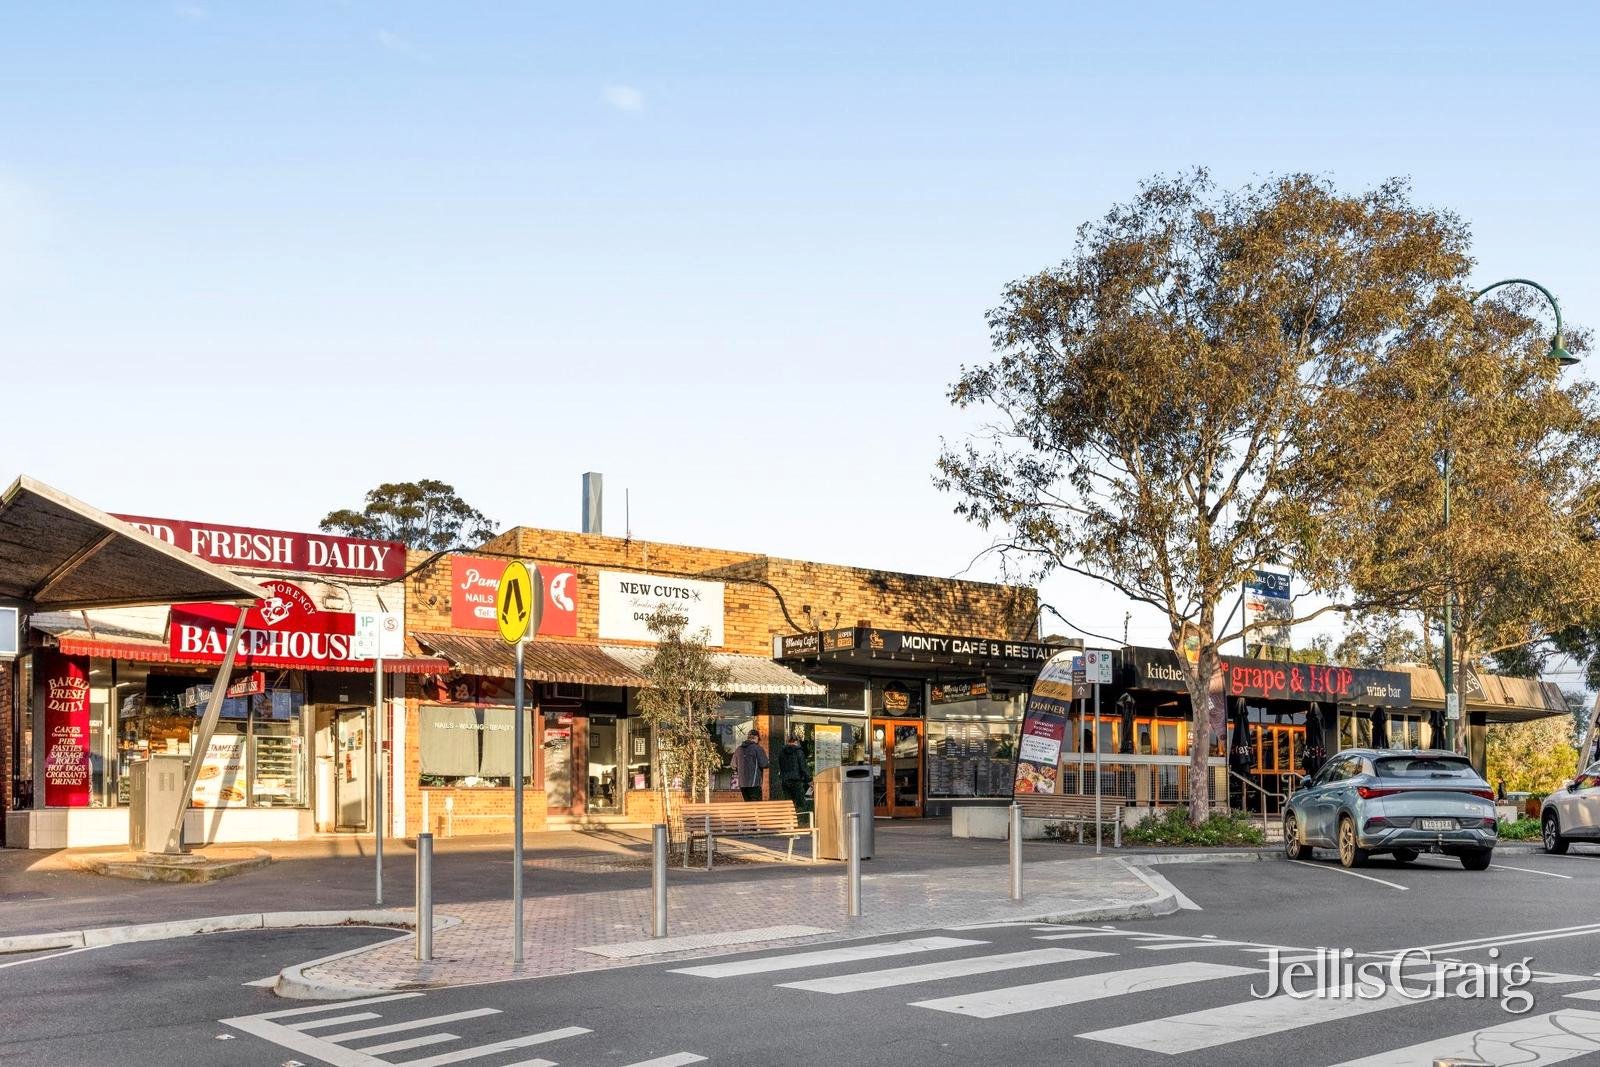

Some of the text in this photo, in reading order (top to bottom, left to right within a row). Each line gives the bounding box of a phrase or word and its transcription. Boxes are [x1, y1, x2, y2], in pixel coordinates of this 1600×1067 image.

[189, 528, 294, 564] FRESH
[307, 540, 391, 572] DAILY
[465, 592, 494, 603] NAILS
[620, 582, 690, 599] NEW CUTS
[267, 584, 316, 615] MORENCY
[361, 616, 374, 627] 1P
[901, 635, 949, 651] MONTY
[952, 640, 987, 655] CAFÉ
[990, 643, 1000, 656] &
[48, 676, 90, 690] BAKED
[1231, 664, 1286, 698] grape
[1289, 667, 1305, 693] &
[1308, 664, 1353, 695] HOP
[50, 688, 87, 700] FRESH
[1366, 682, 1402, 698] wine bar
[48, 699, 85, 713] DAILY
[1030, 701, 1065, 715] DINNER
[54, 725, 81, 734] CAKES
[489, 723, 515, 731] BEAUTY
[51, 751, 84, 759] SAUSAGE
[46, 771, 87, 779] CROISSANTS
